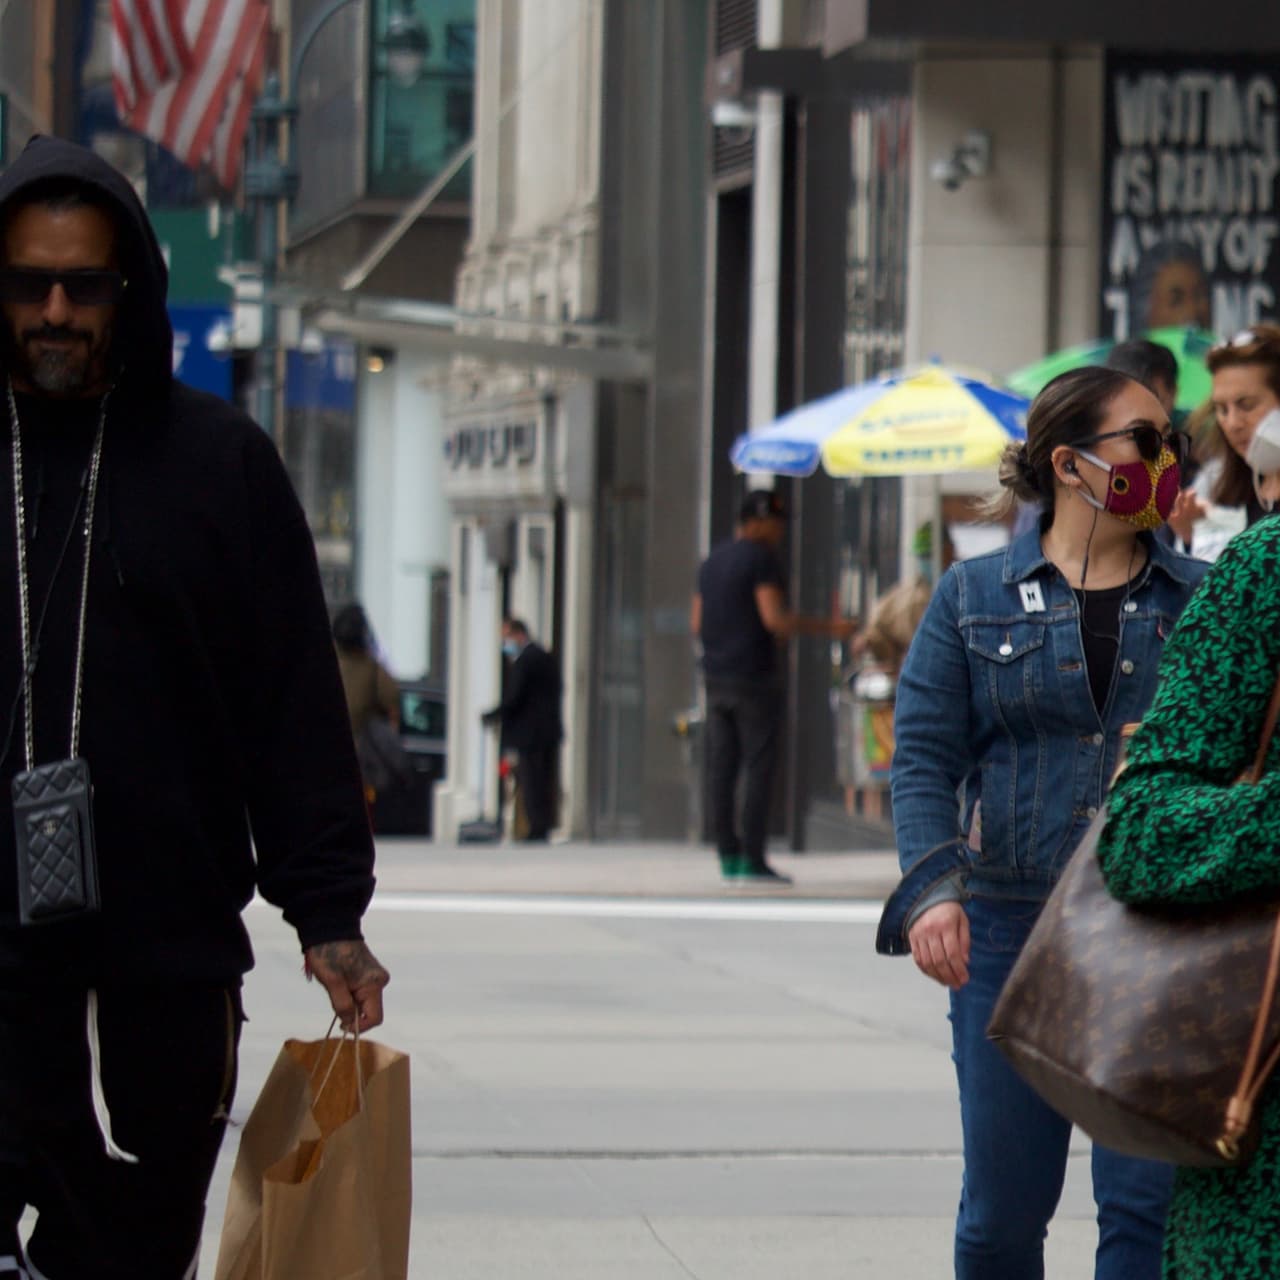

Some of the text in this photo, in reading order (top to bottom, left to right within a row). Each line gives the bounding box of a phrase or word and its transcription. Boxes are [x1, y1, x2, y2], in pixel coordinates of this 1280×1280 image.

[1114, 70, 1278, 156] WRITING
[1111, 152, 1153, 217] IS
[1222, 217, 1278, 274] OF
